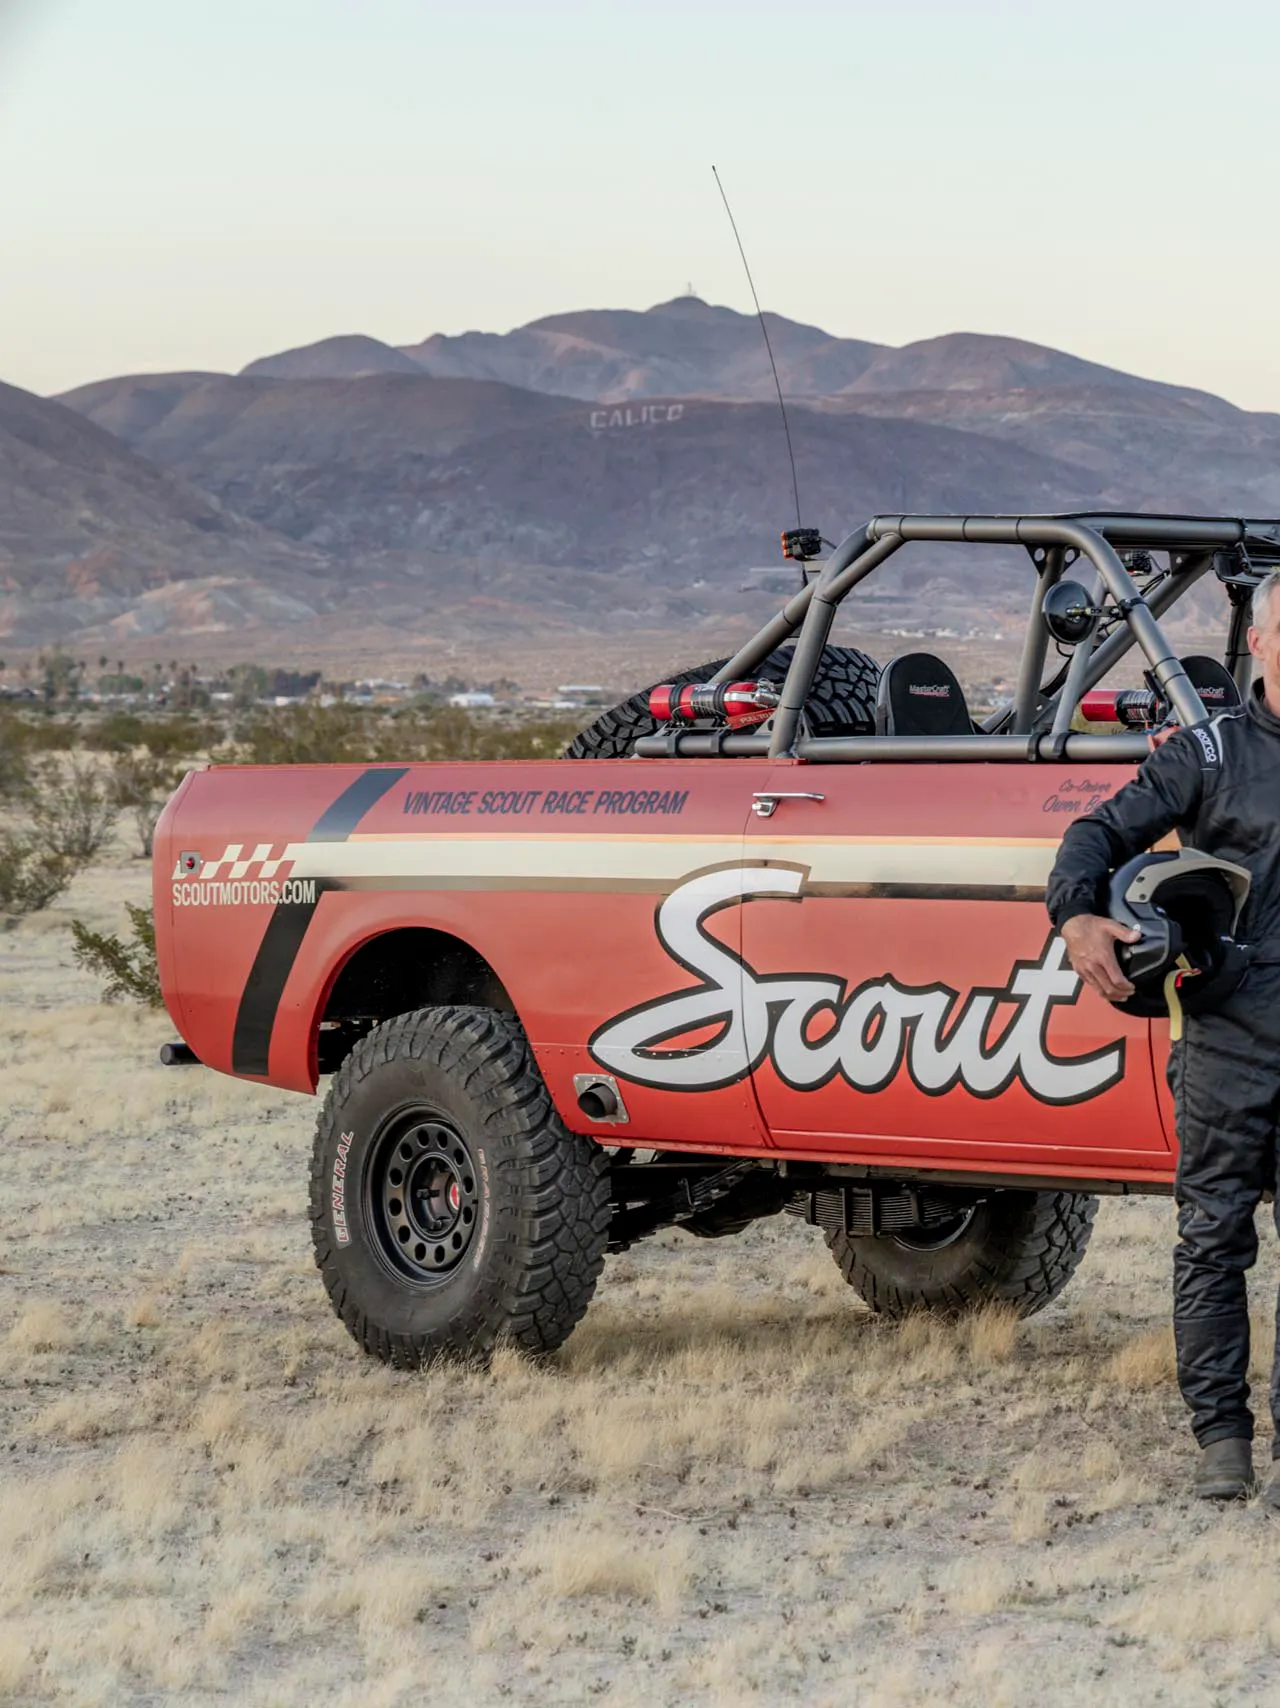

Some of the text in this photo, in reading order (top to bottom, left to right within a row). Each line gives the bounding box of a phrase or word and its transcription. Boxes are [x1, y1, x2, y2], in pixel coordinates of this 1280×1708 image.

[590, 404, 684, 429] CALICO
[1191, 728, 1216, 763] sparco
[403, 790, 690, 814] VINTAGE SCOUT RACE PROGRAM
[1043, 795, 1081, 812] Owen
[172, 880, 316, 906] SCOUTMOTORS.COM
[588, 859, 1126, 1105] Scout
[332, 1131, 354, 1242] GENERAL
